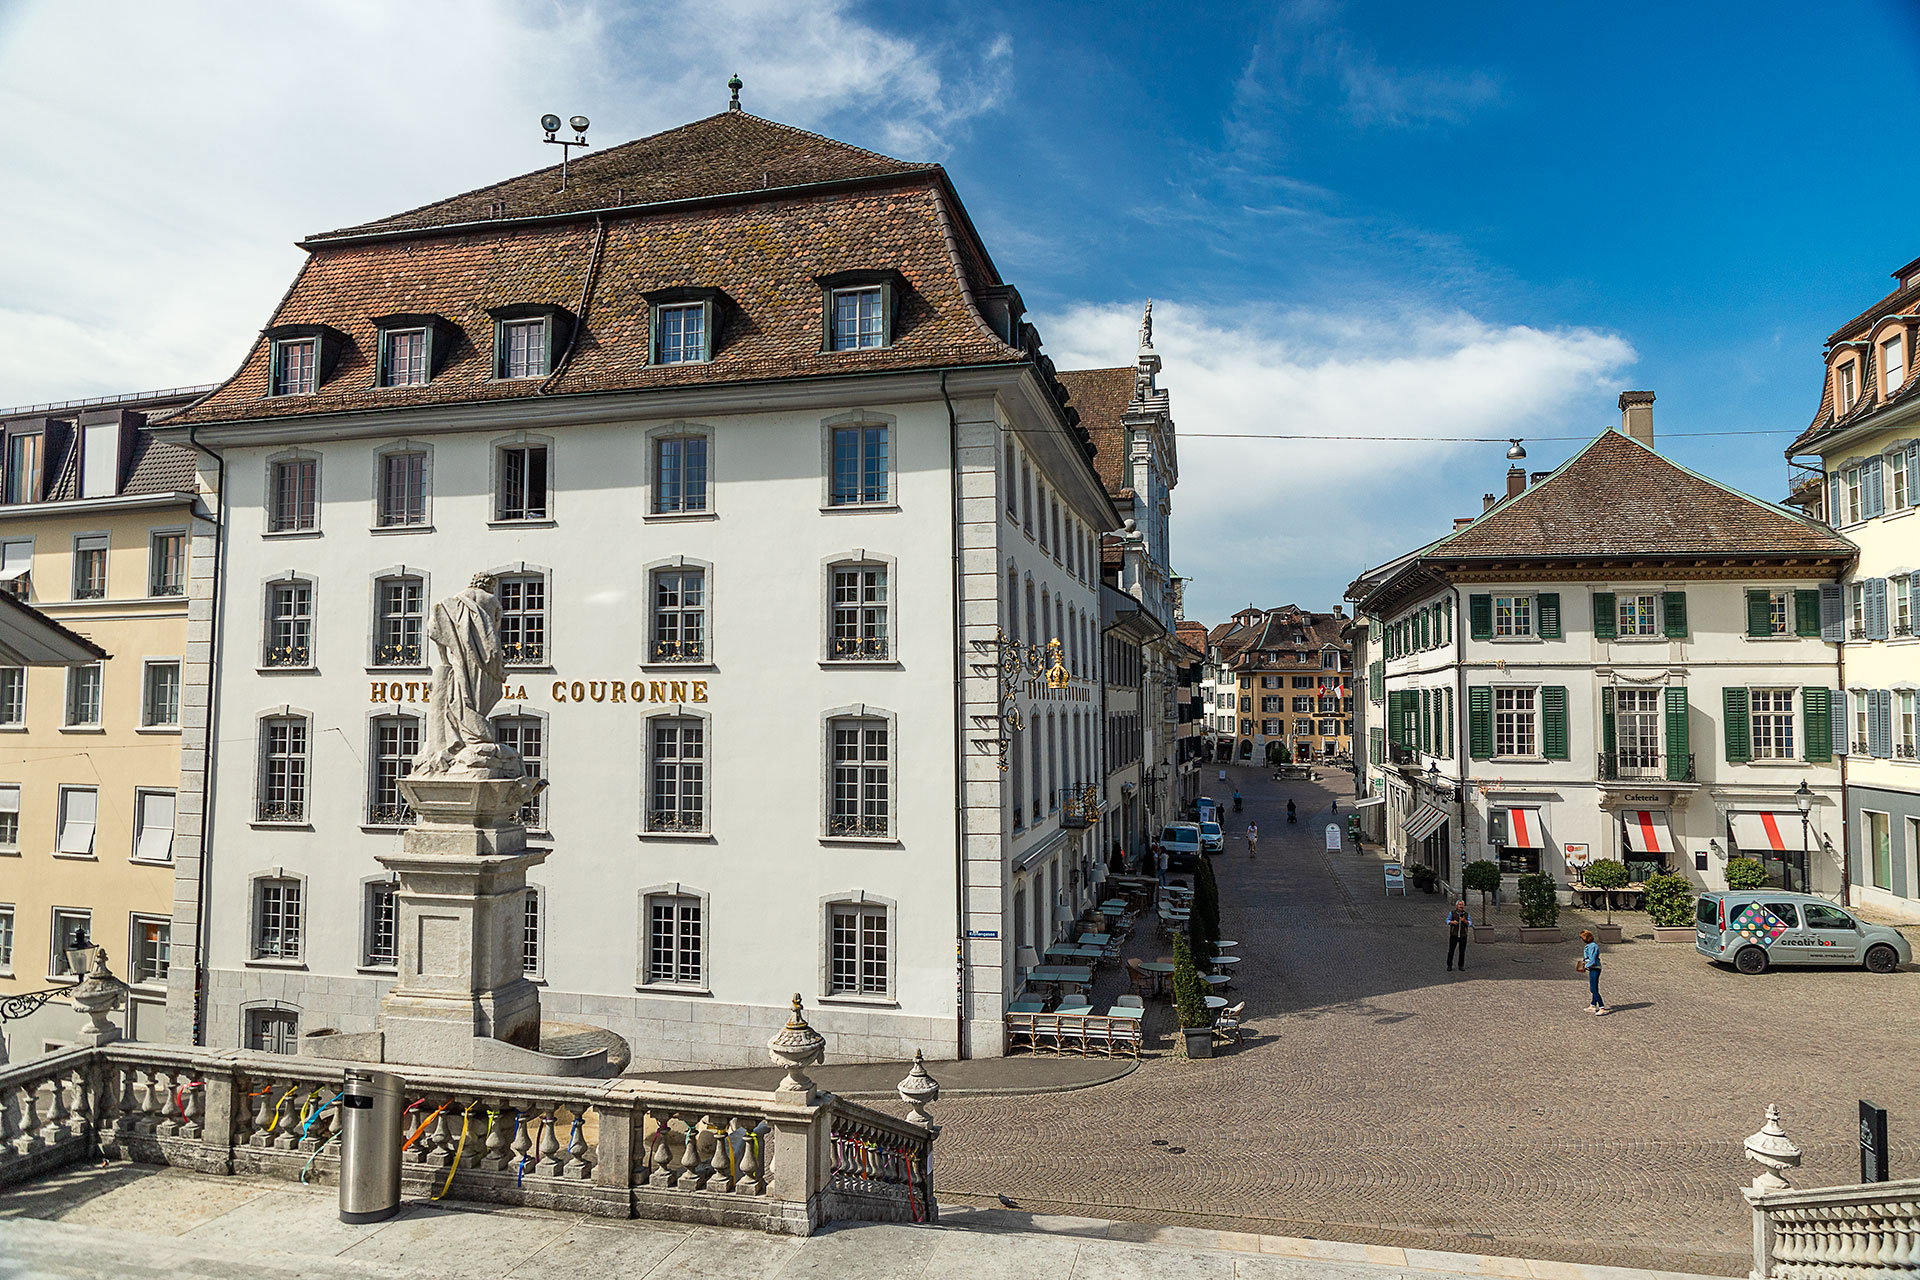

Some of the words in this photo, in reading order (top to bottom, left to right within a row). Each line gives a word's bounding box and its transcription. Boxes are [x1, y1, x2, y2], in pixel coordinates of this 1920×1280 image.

[369, 681, 431, 703] HOTE
[503, 685, 528, 700] LA
[552, 681, 708, 703] COURONNE
[1624, 793, 1659, 801] Cafeteria
